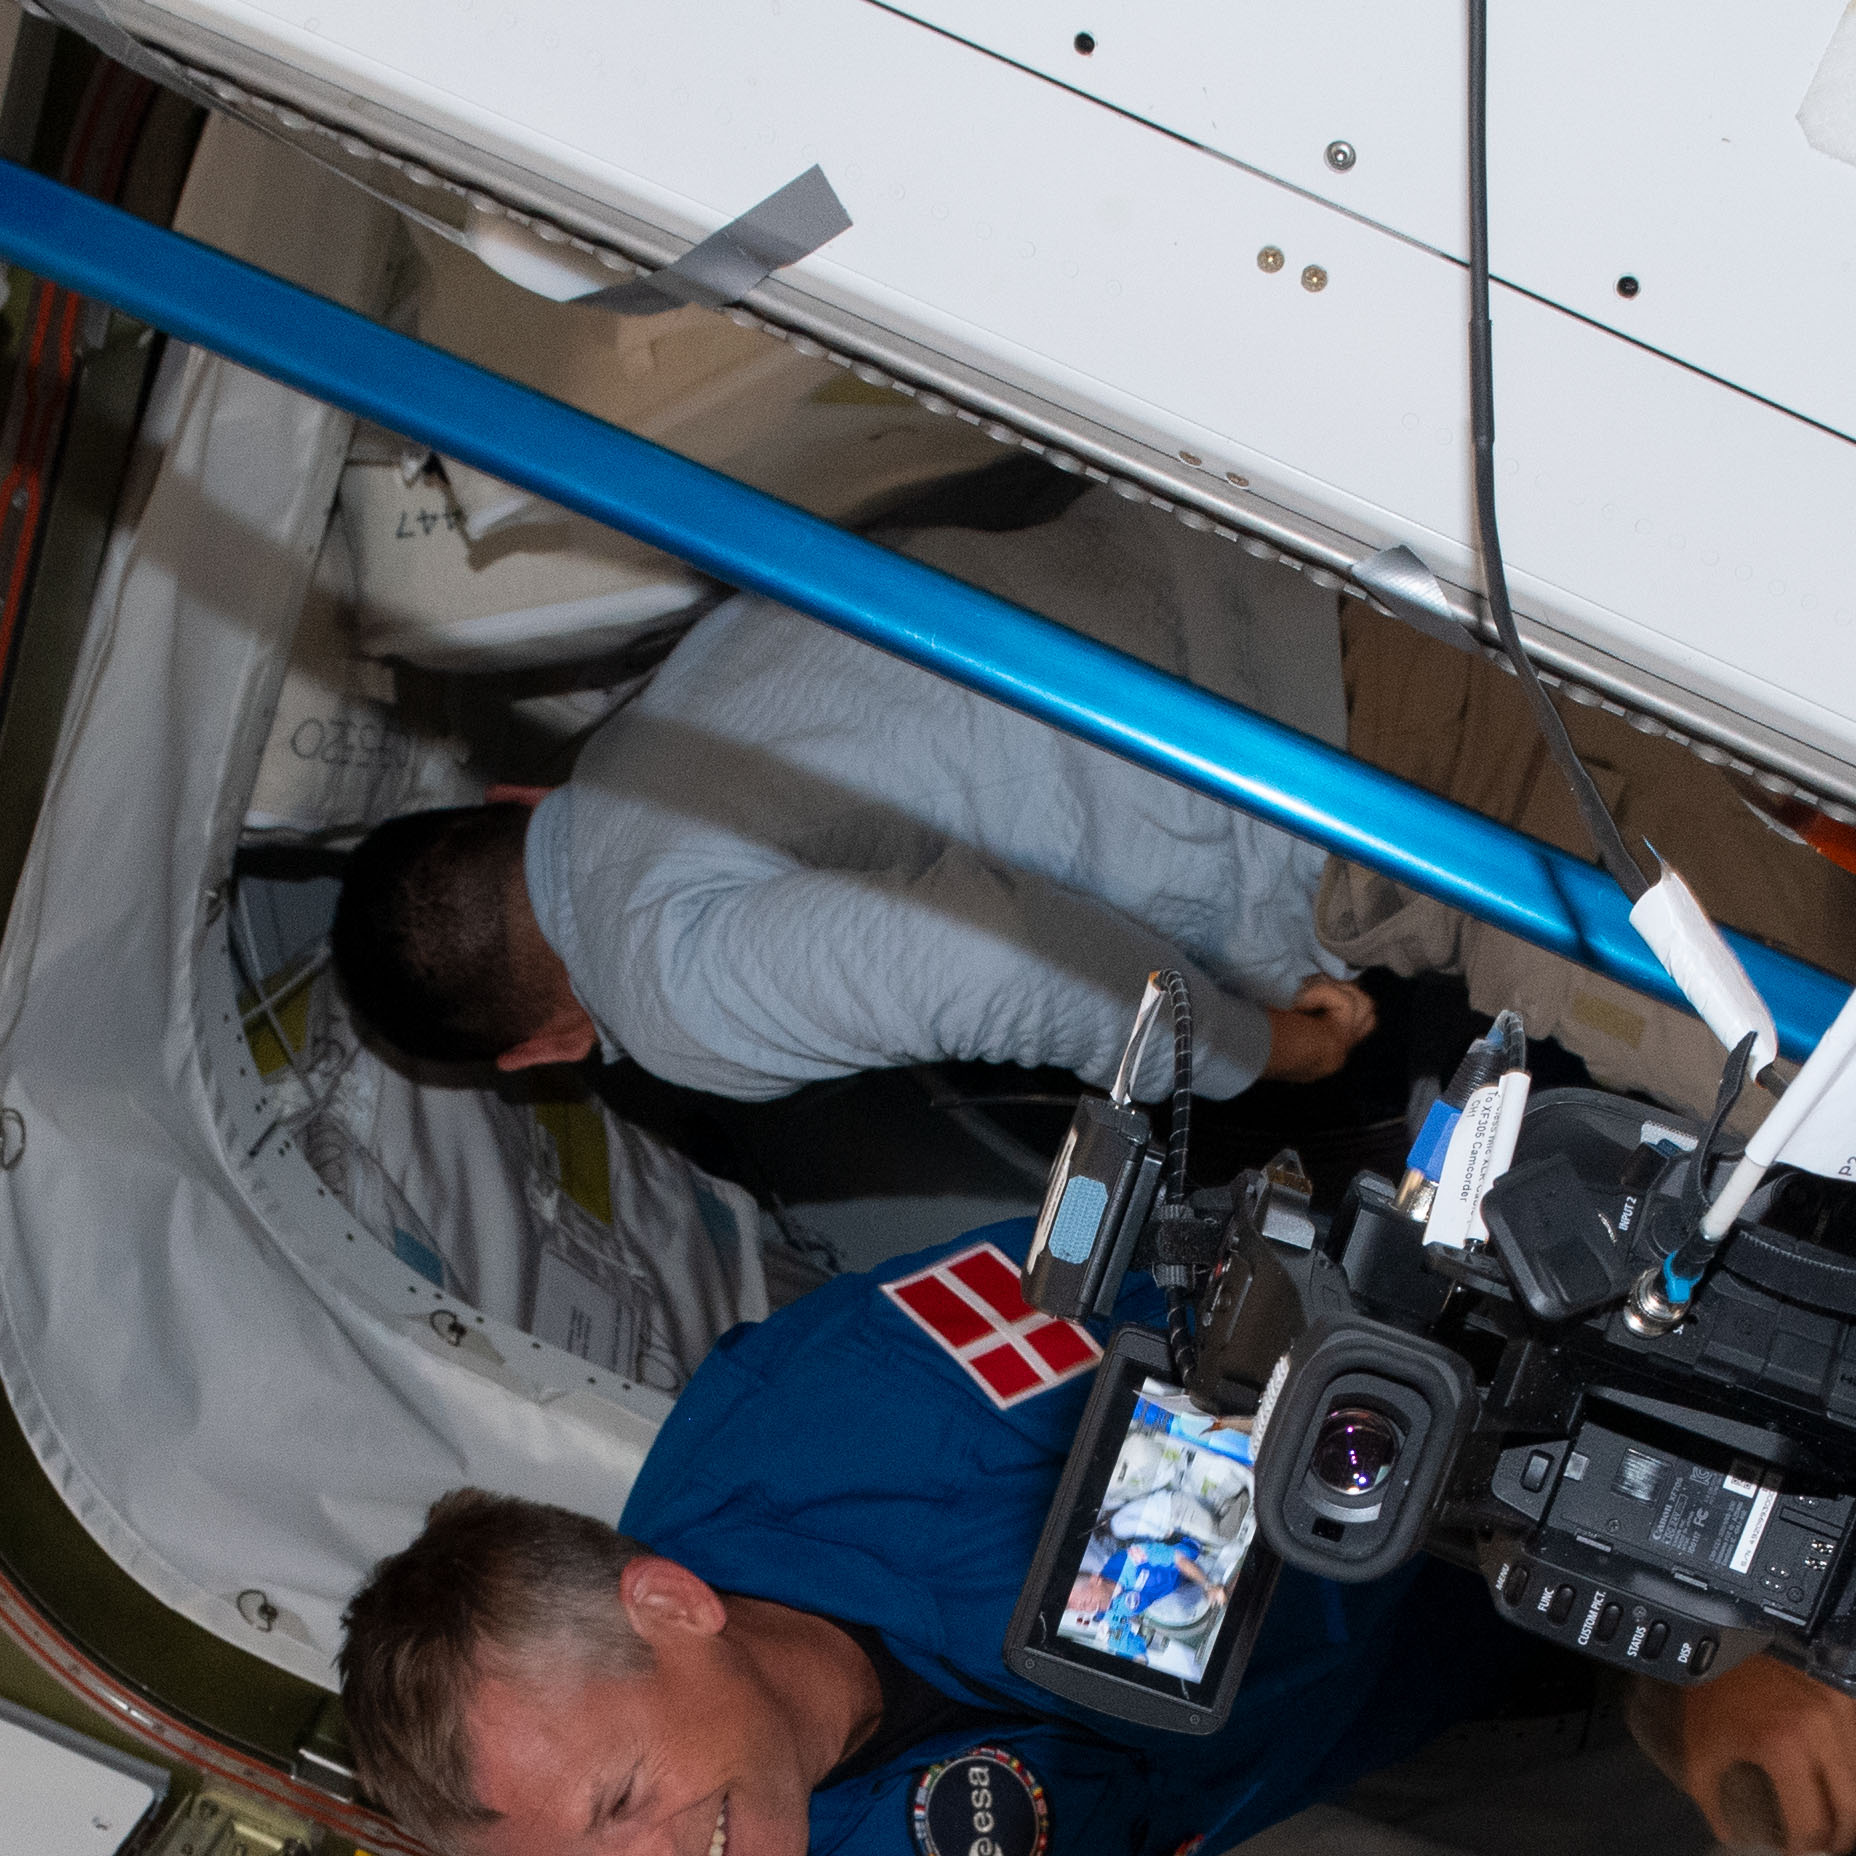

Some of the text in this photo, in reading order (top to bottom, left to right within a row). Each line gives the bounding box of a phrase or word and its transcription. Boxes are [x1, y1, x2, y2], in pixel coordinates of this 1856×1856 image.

[1466, 1098, 1480, 1118] CH1
[1459, 1091, 1499, 1203] To XF305 Camcorder
[1618, 1195, 1637, 1231] INPUT 2
[1651, 1502, 1673, 1541] Canon
[1495, 1563, 1510, 1591] MENU
[1537, 1587, 1555, 1612] FUNC
[1578, 1591, 1607, 1646] CUSTOM PICT.
[1627, 1626, 1648, 1657] STATUS
[1678, 1642, 1693, 1664] DISP
[967, 1765, 995, 1833] esa
